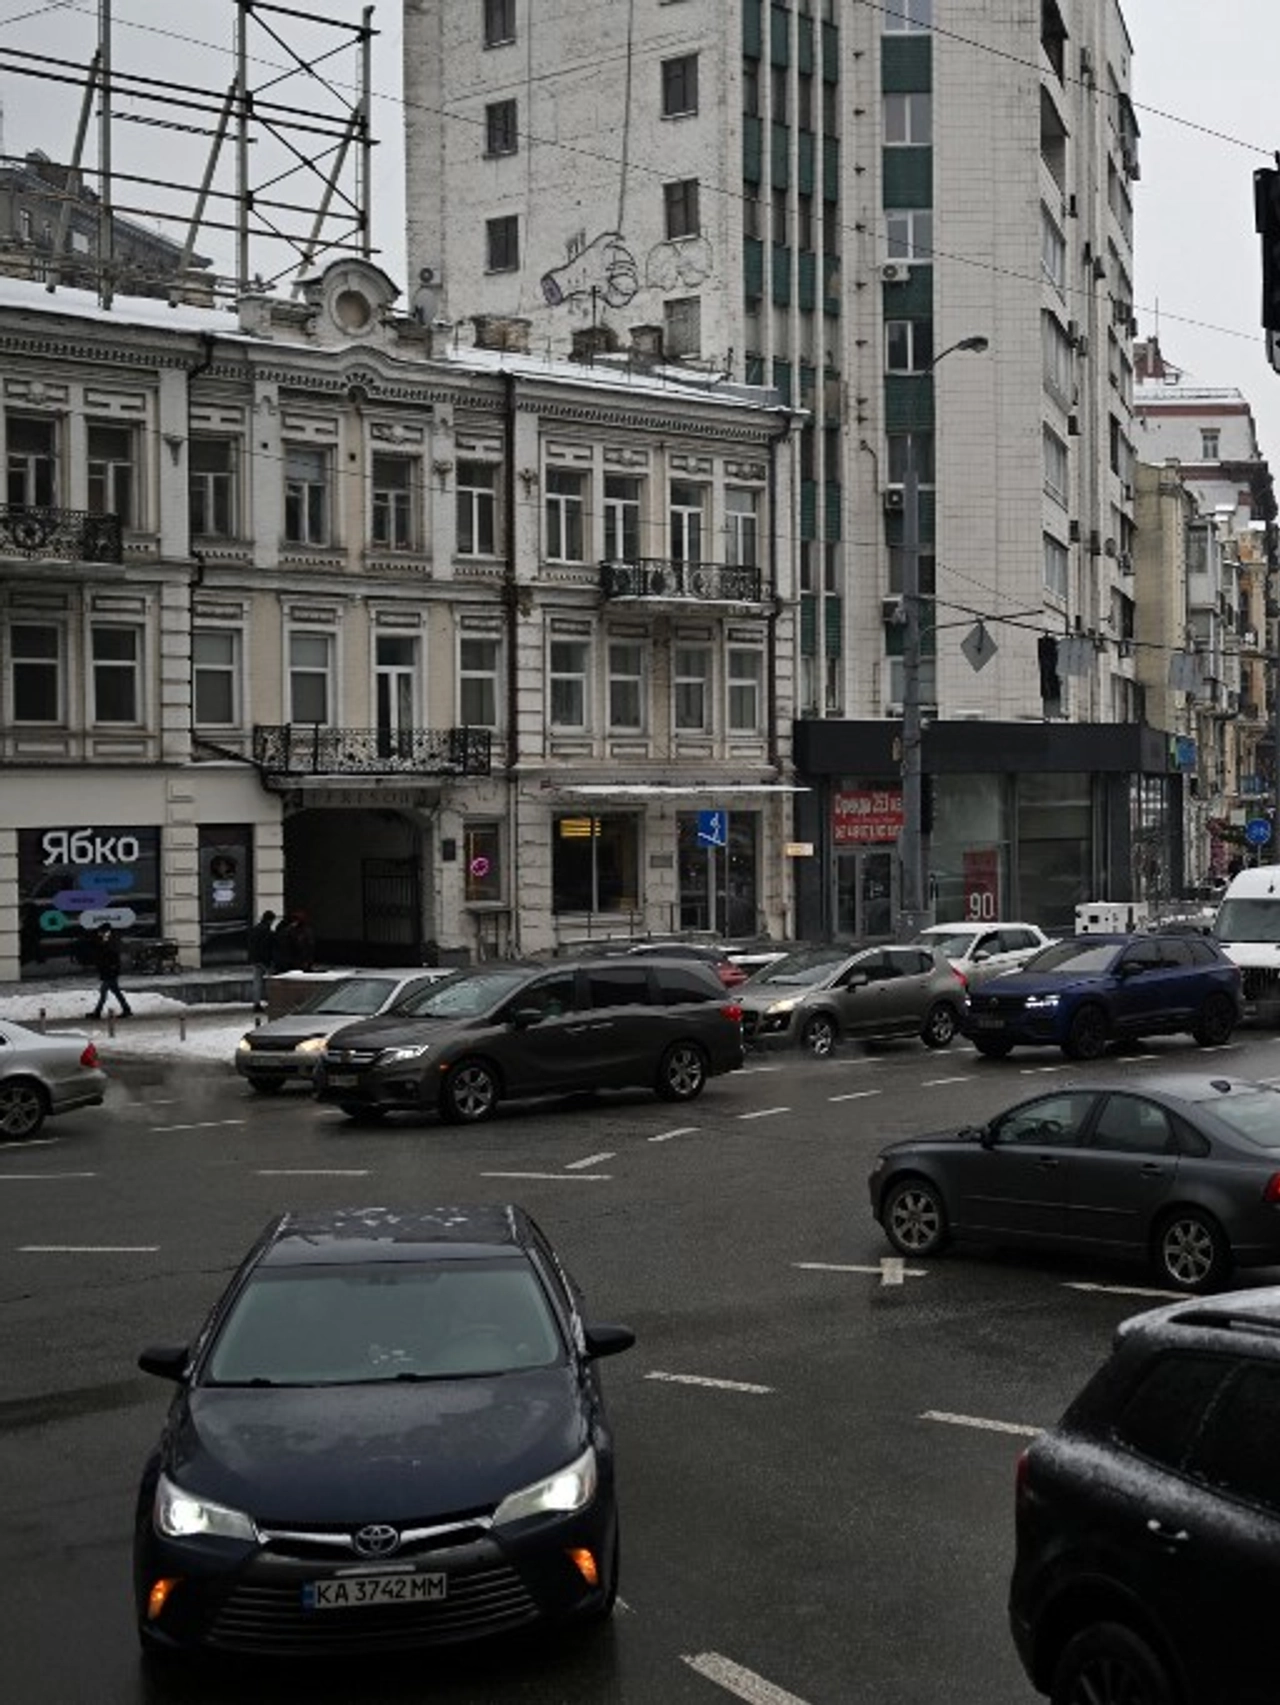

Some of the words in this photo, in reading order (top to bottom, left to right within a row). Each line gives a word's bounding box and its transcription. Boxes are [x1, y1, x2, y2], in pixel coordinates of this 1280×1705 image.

[42, 827, 139, 866] Ябко
[970, 892, 994, 919] 90
[317, 1583, 349, 1604] KA
[355, 1578, 407, 1601] 3742
[410, 1575, 444, 1598] MM
